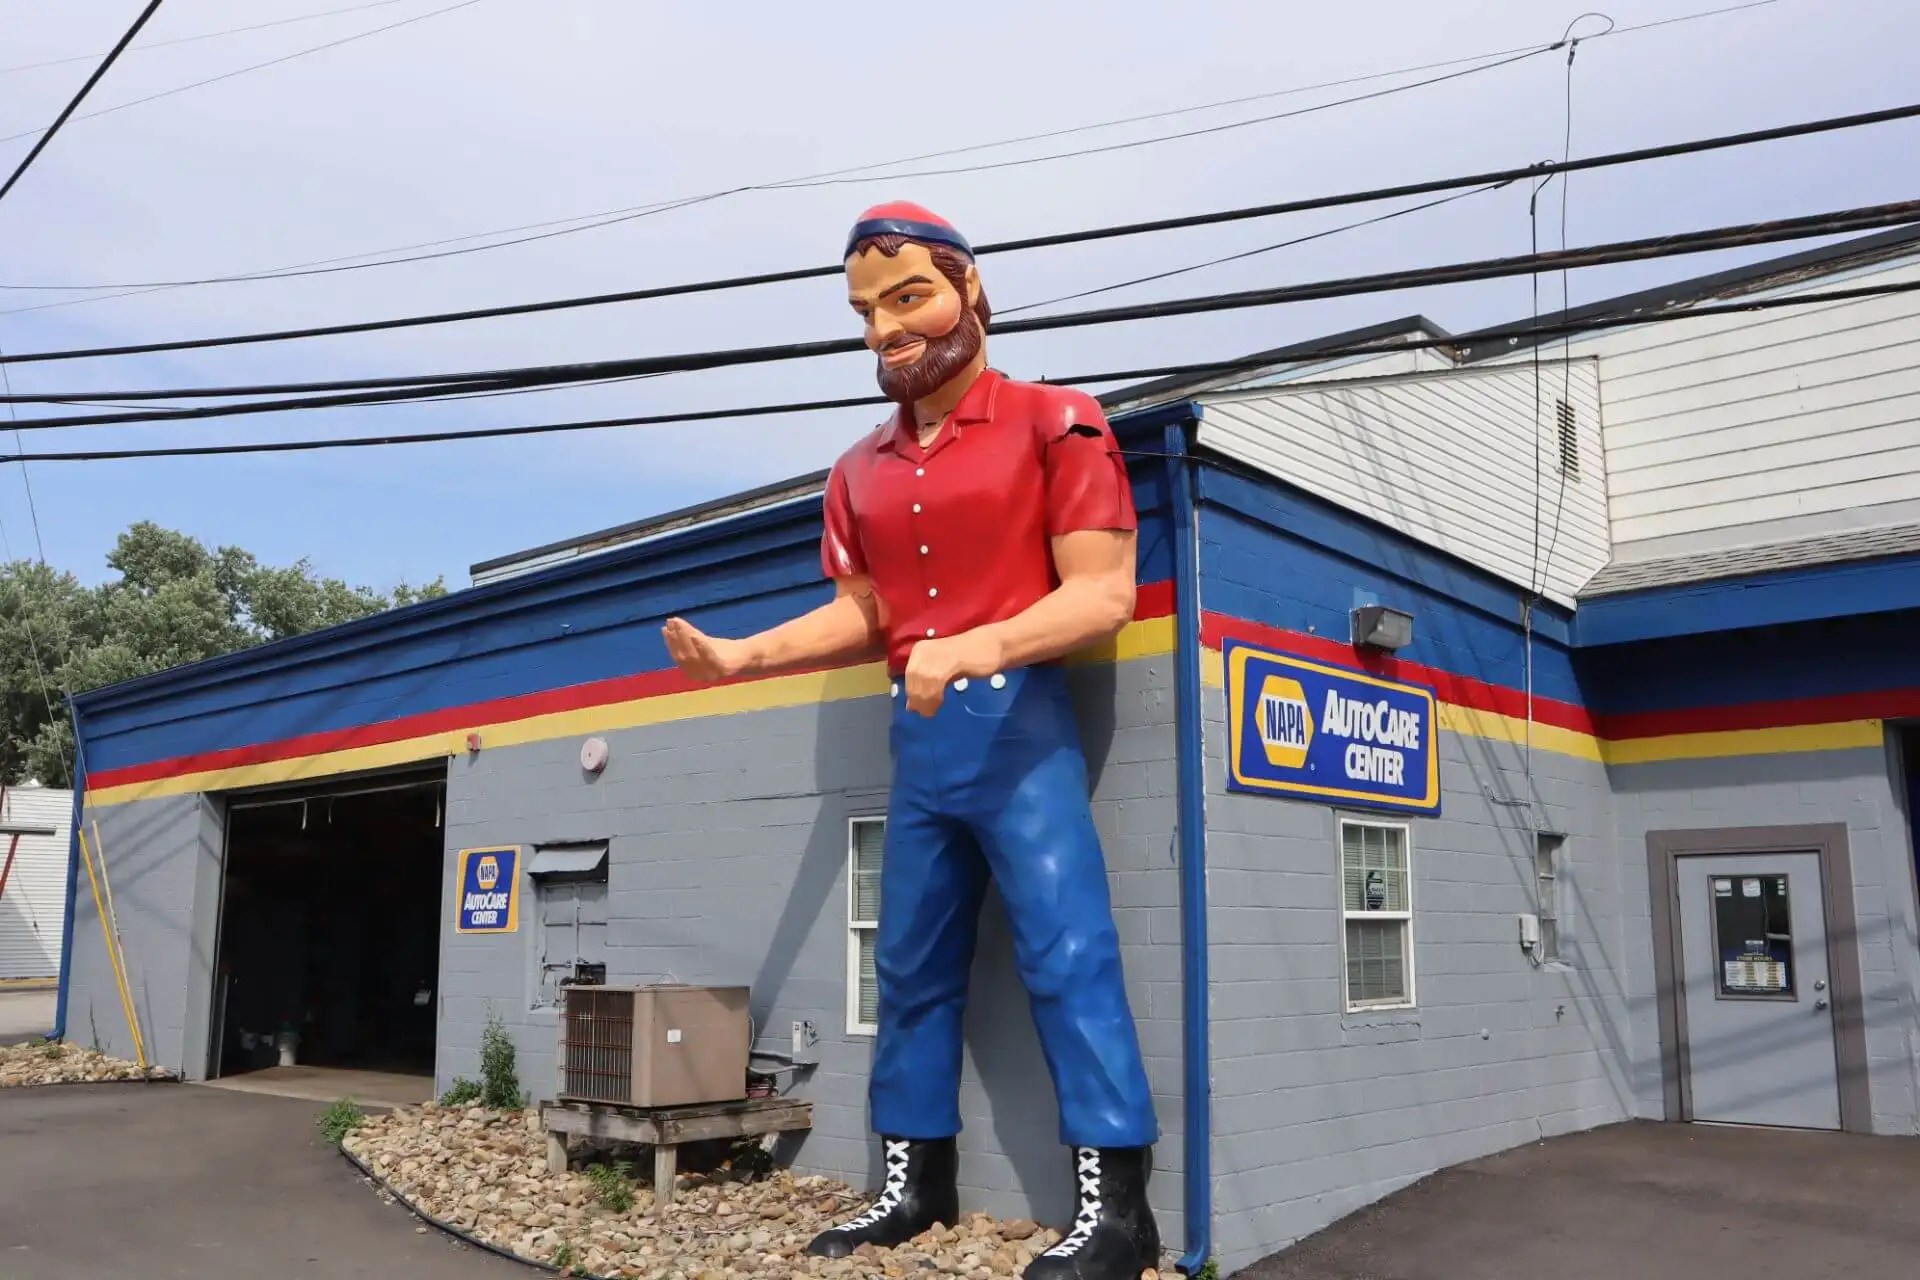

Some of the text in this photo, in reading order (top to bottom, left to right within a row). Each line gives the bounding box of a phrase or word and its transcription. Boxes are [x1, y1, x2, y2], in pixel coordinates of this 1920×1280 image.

[1266, 699, 1305, 745] NAPA
[1345, 743, 1404, 786] CENTER
[480, 865, 496, 880] NAPA
[472, 911, 497, 924] CENTER
